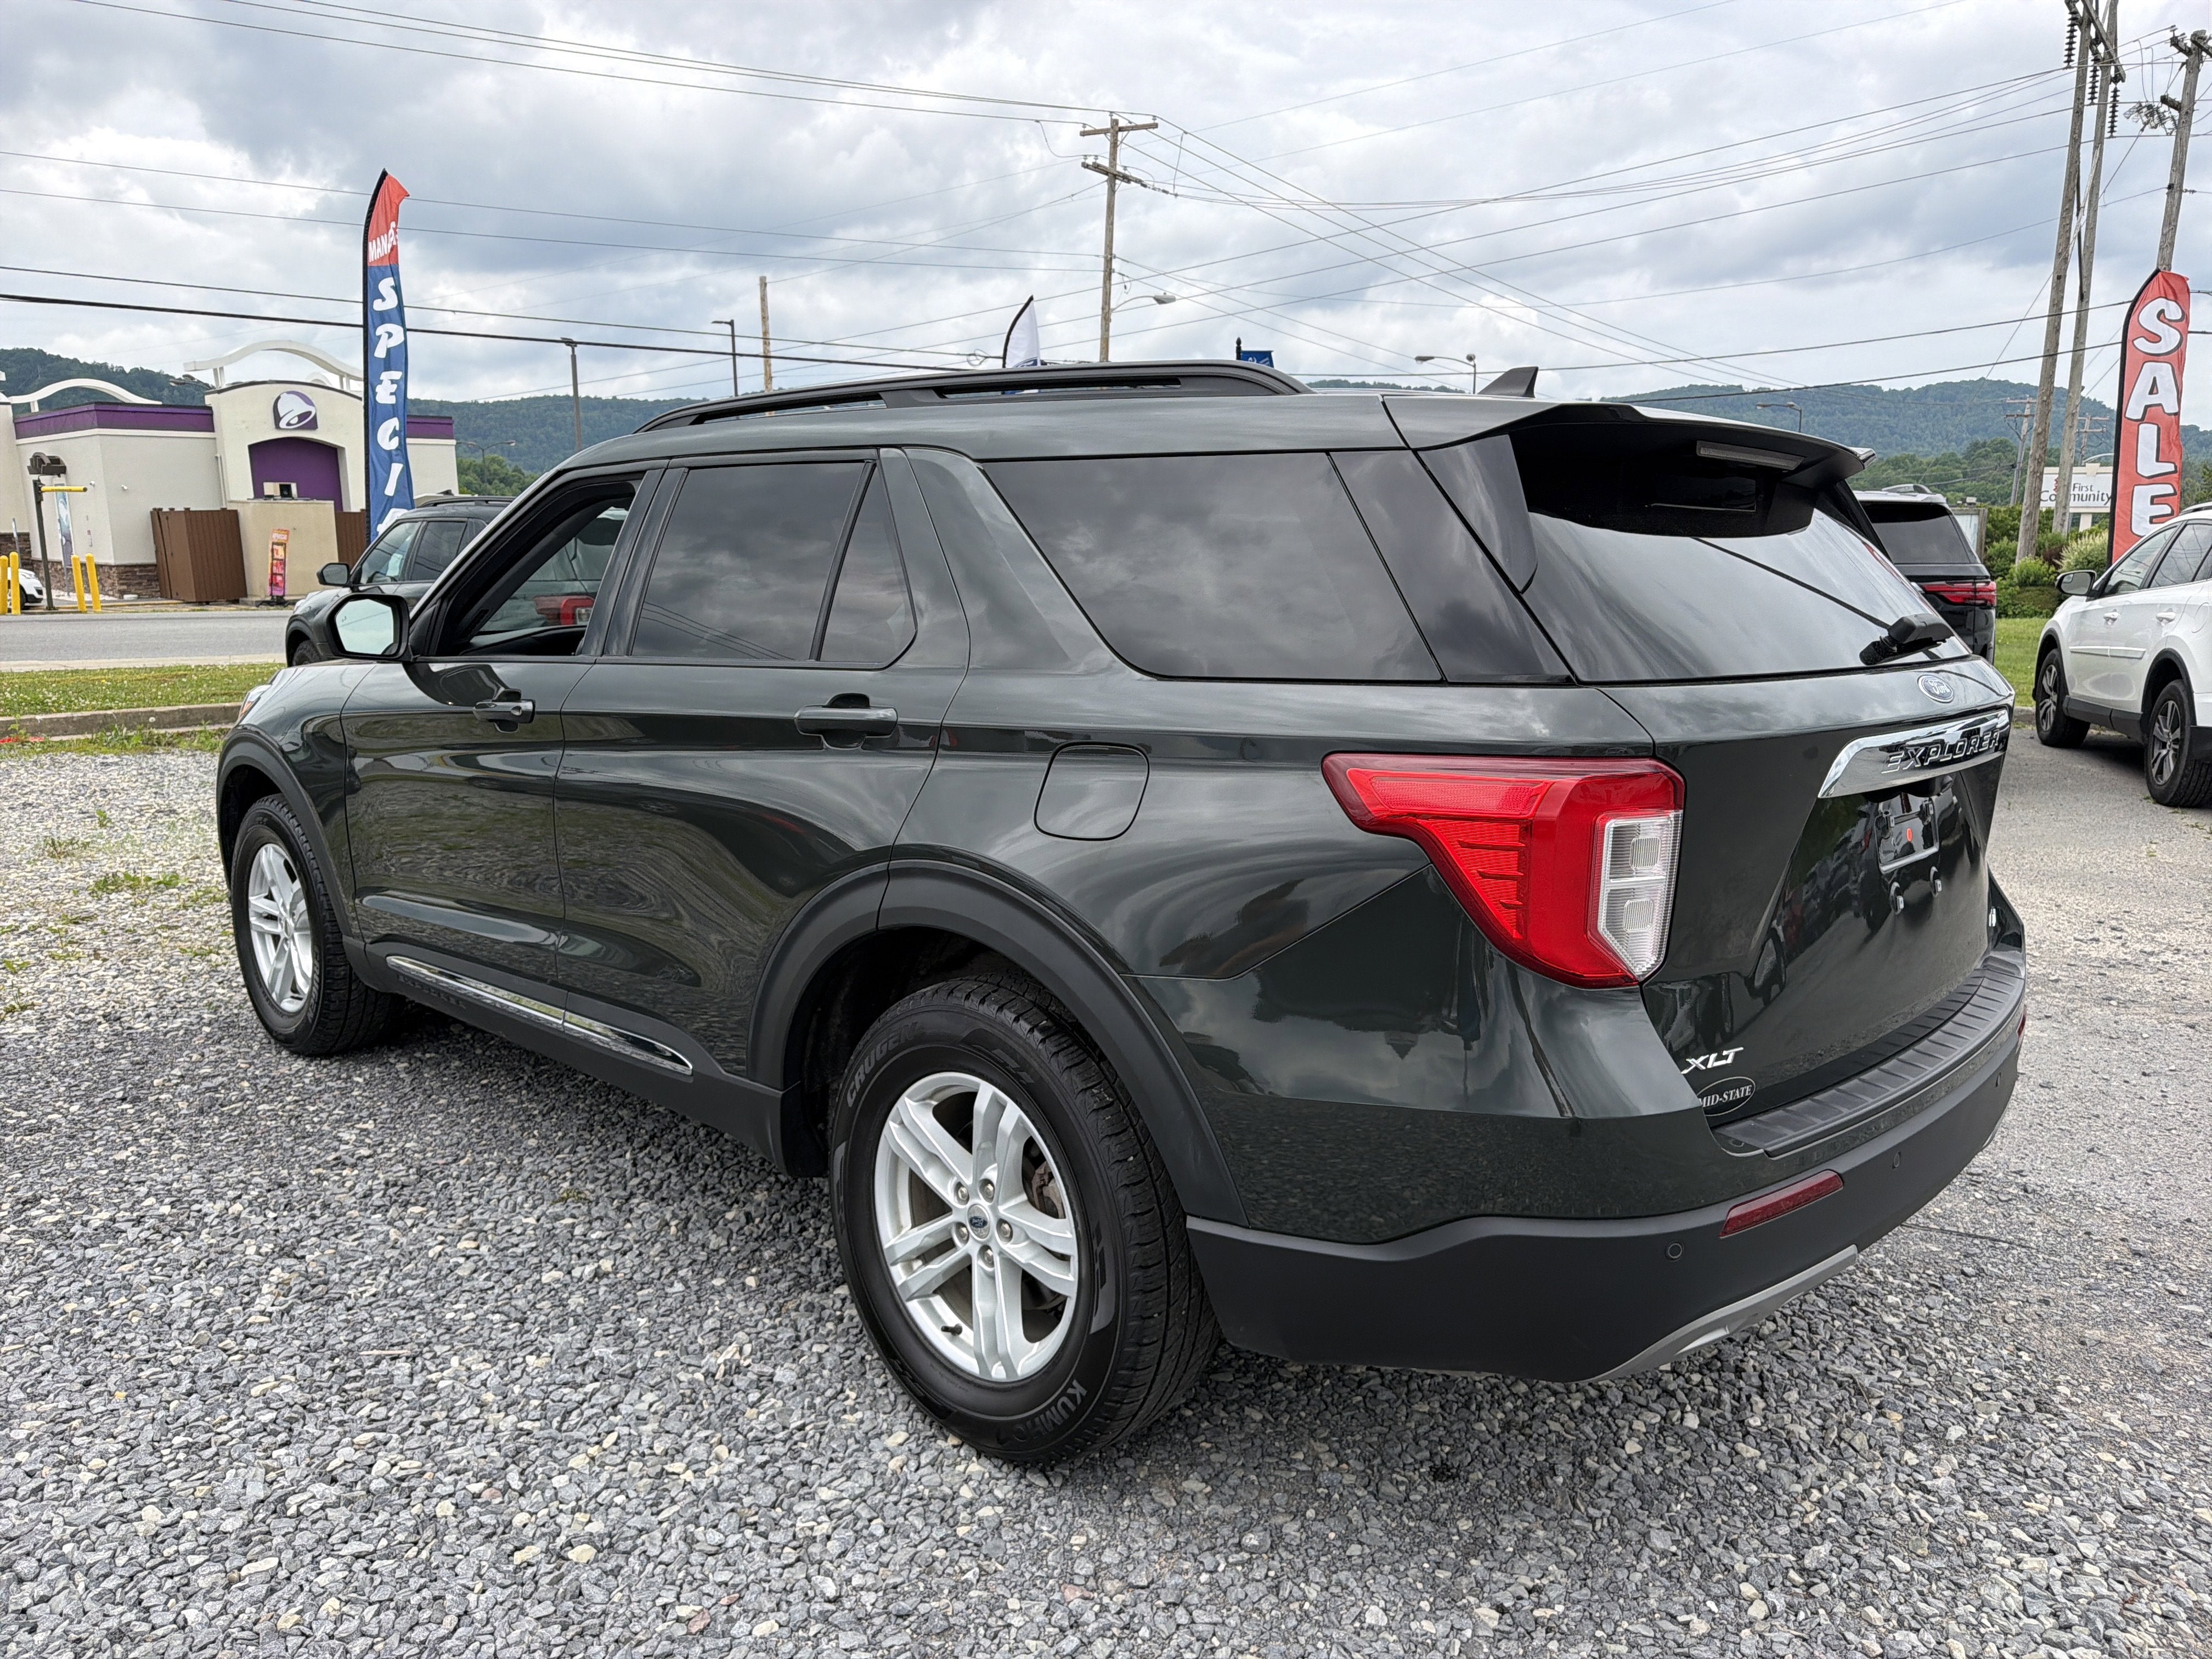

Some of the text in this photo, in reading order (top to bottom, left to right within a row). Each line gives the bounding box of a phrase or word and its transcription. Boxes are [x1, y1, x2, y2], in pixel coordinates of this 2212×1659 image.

[2124, 296, 2186, 537] SALE
[2073, 483, 2094, 492] First
[1881, 729, 2000, 774] EXPLORER
[847, 1021, 919, 1107] CRUGEN
[1681, 1047, 1744, 1074] XLT
[1699, 1085, 1752, 1108] MID-STATE
